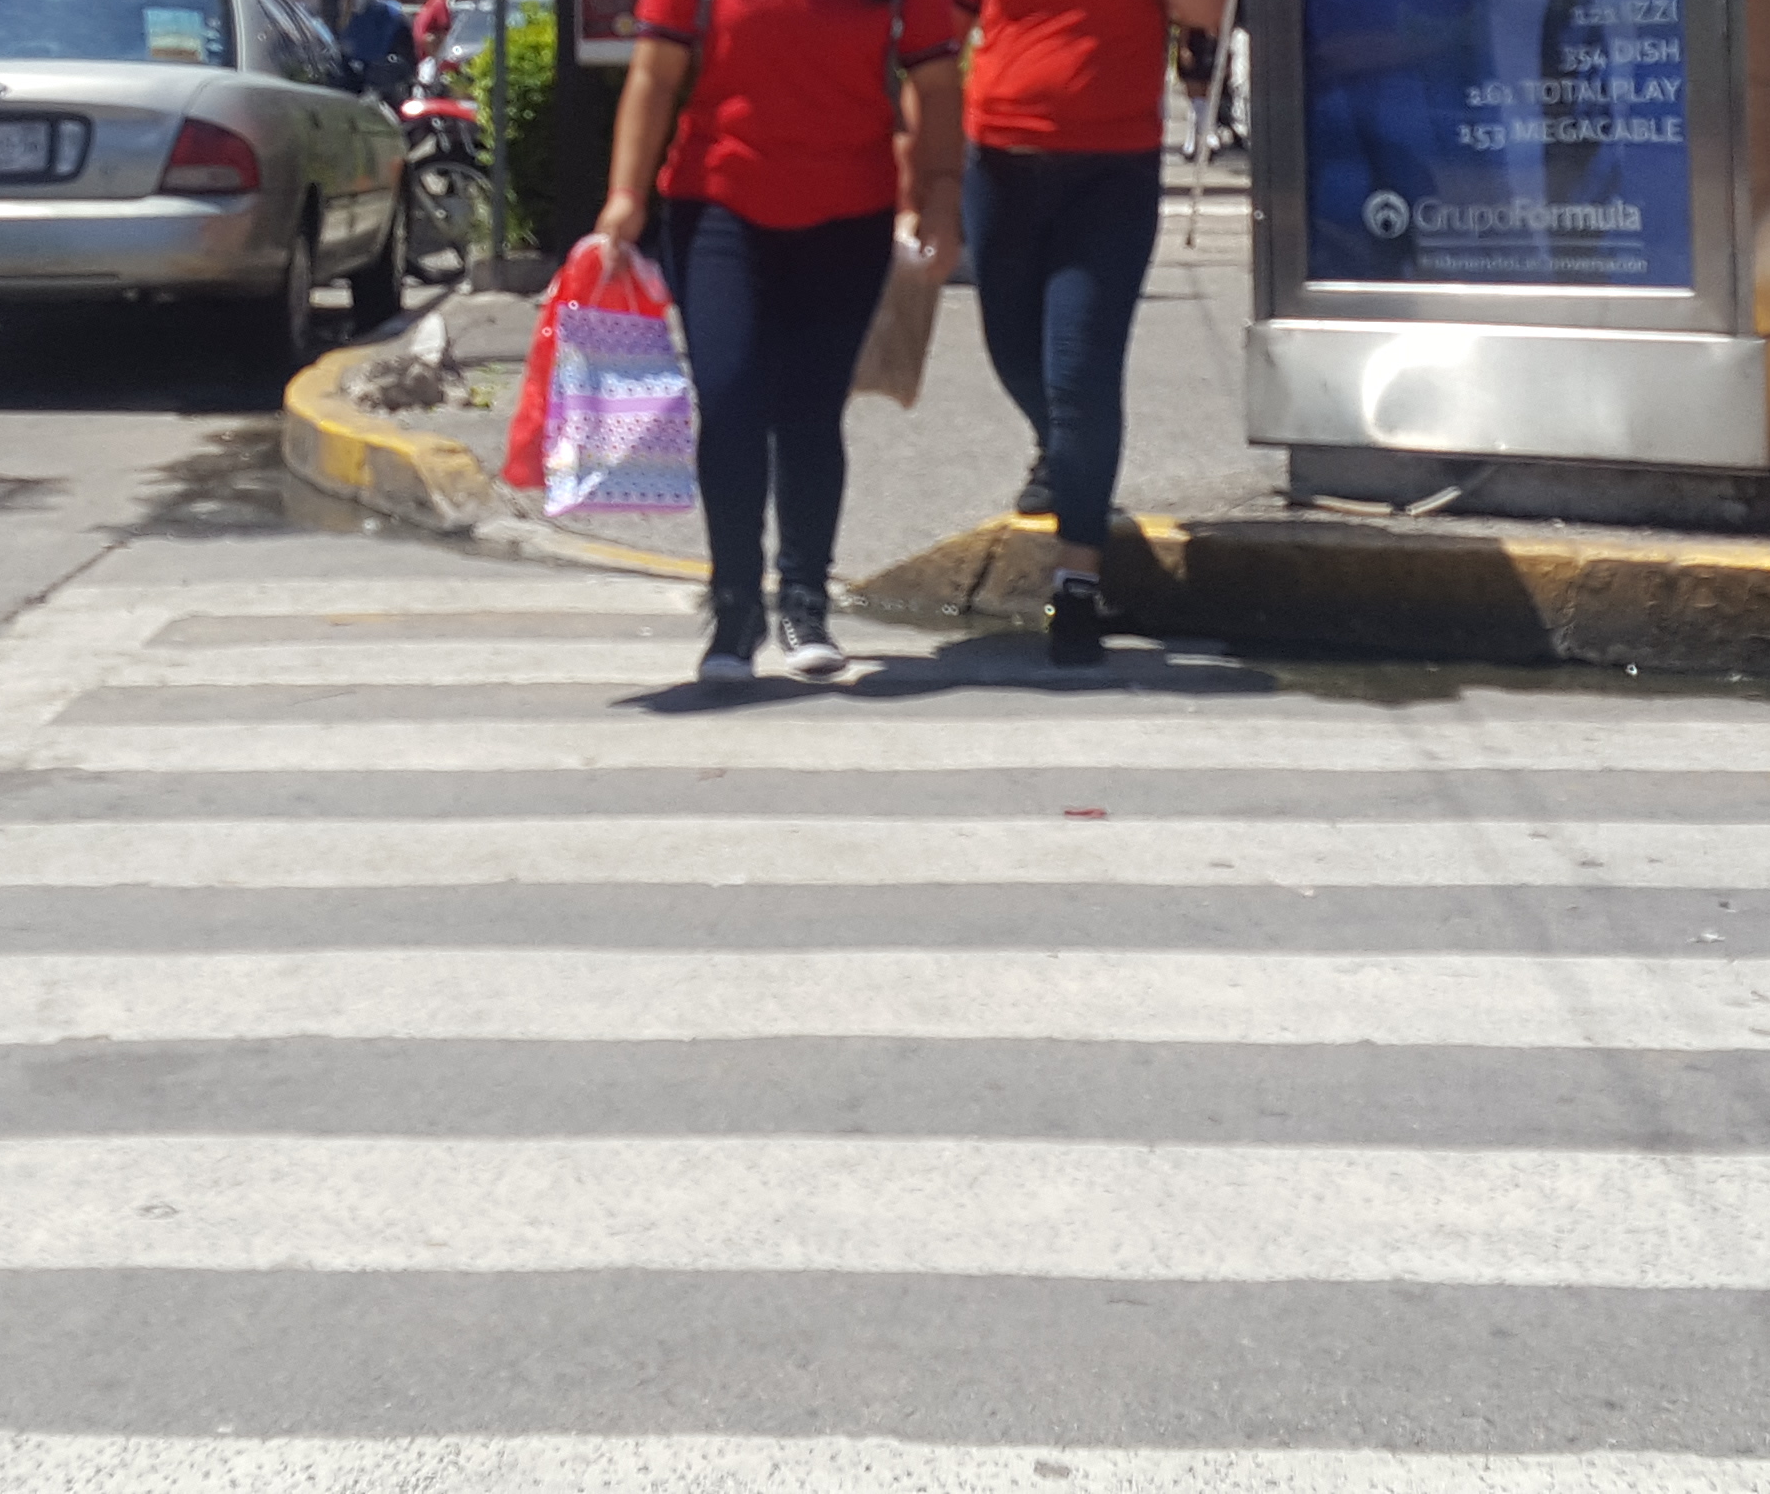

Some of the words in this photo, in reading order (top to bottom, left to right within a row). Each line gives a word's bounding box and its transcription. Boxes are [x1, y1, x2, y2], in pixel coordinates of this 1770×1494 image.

[1558, 46, 1607, 73] 354
[1611, 37, 1681, 64] DISH
[1520, 76, 1682, 105] TOTALPLAY
[1509, 115, 1684, 143] MEGACABLE
